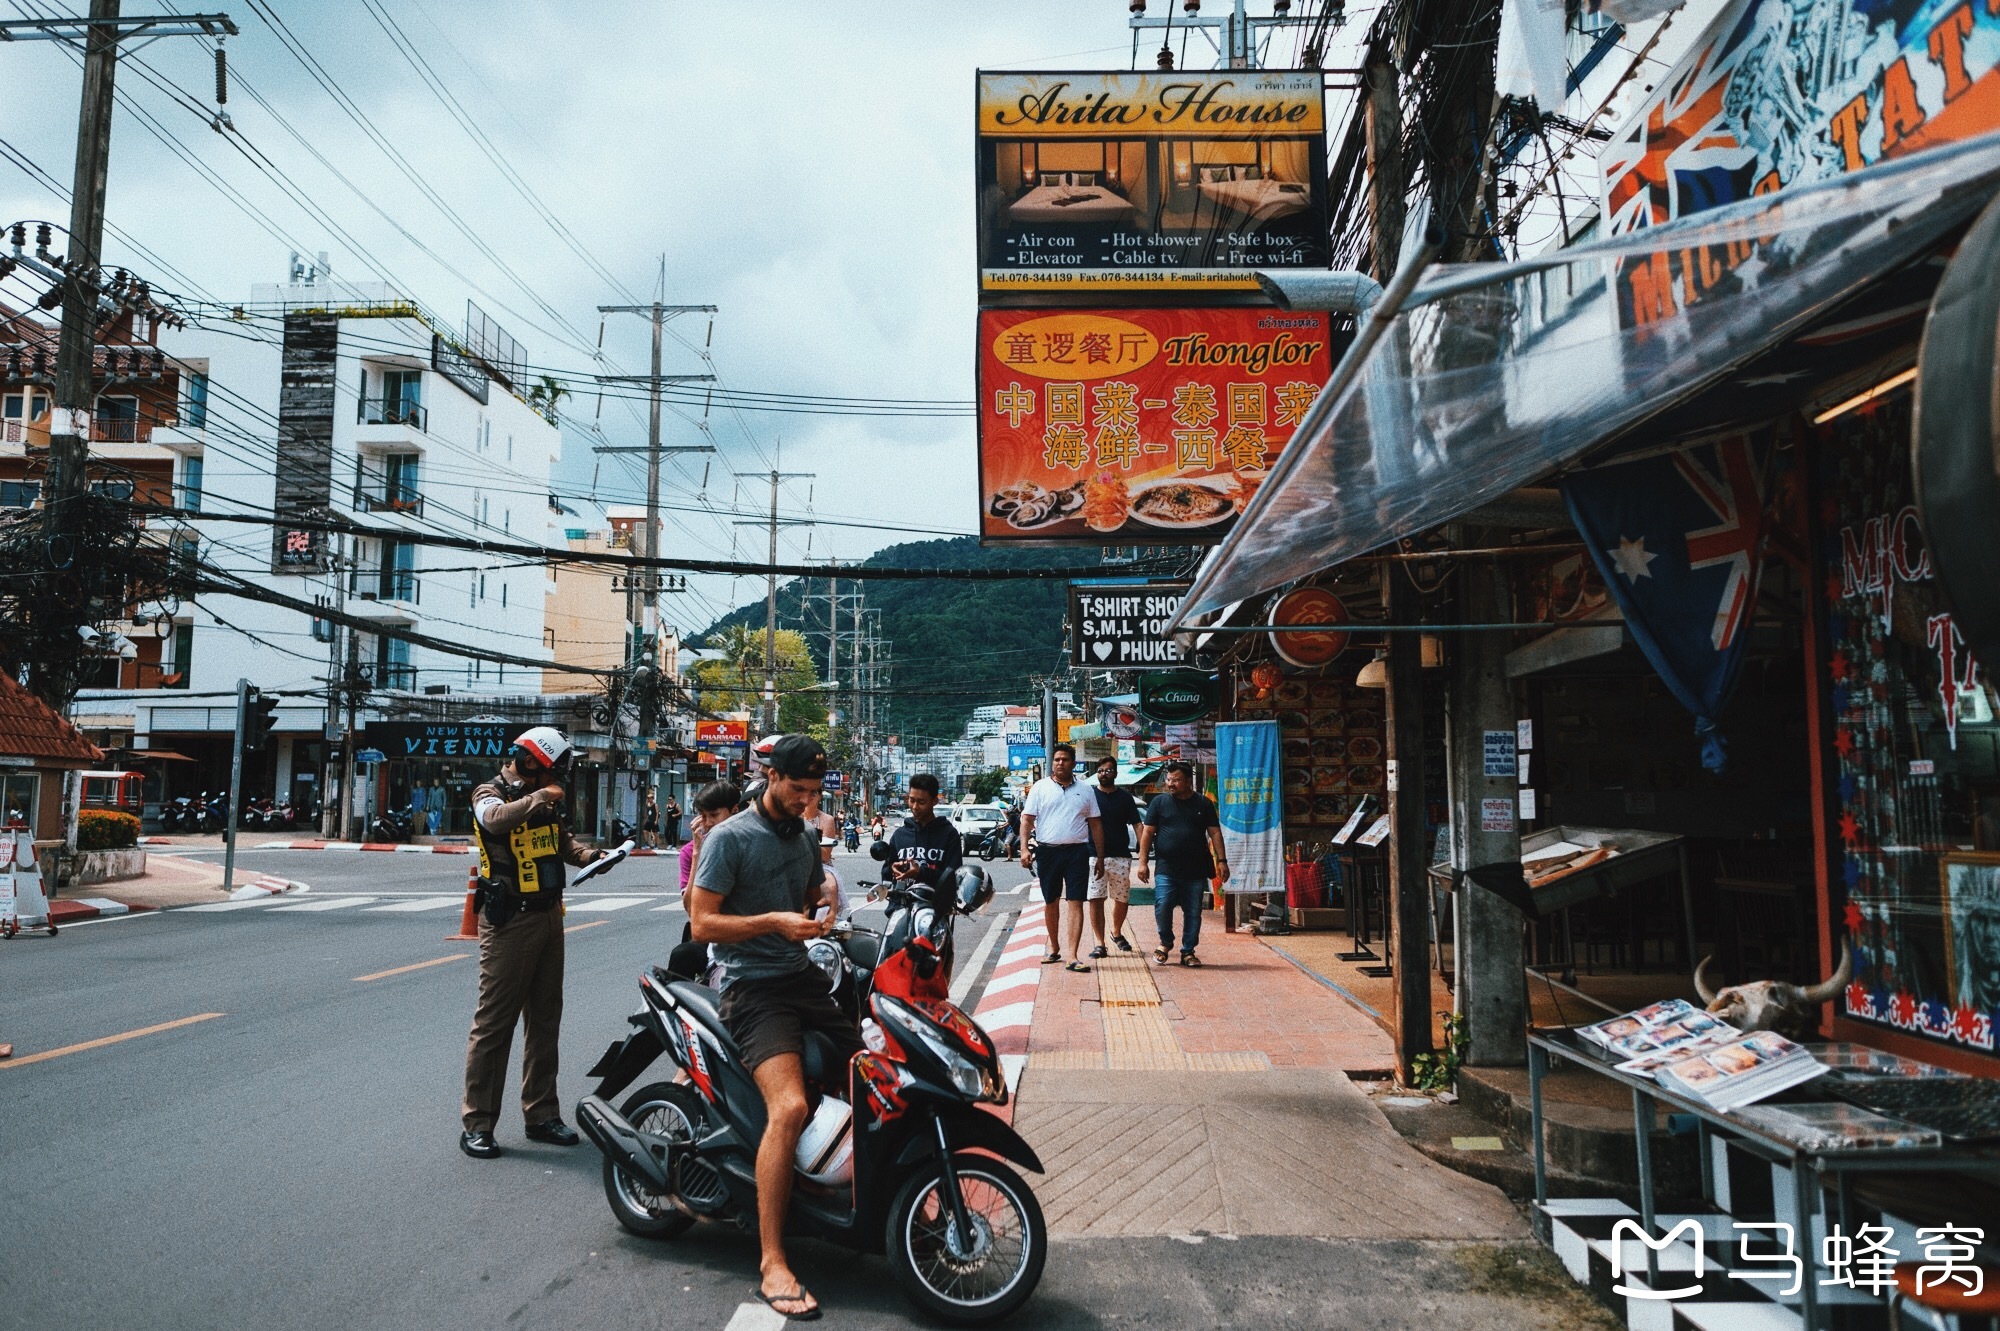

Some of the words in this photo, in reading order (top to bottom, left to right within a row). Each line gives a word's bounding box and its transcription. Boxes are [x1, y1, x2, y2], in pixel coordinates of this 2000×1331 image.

[996, 83, 1147, 125] Arita
[1154, 82, 1309, 123] House
[1048, 236, 1075, 247] con
[1147, 233, 1201, 246] shower
[1266, 232, 1294, 246] box
[1161, 252, 1179, 264] tv.
[1268, 251, 1303, 264] wi-fi
[1003, 331, 1149, 365] 童逻餐厅
[1164, 332, 1322, 377] Thonglor
[1080, 597, 1141, 618] T-SHIRT
[1081, 641, 1086, 662] I
[1165, 691, 1200, 704] Chang
[426, 726, 458, 736] NEW
[463, 726, 505, 736] ERA'S
[537, 738, 555, 755] 6120
